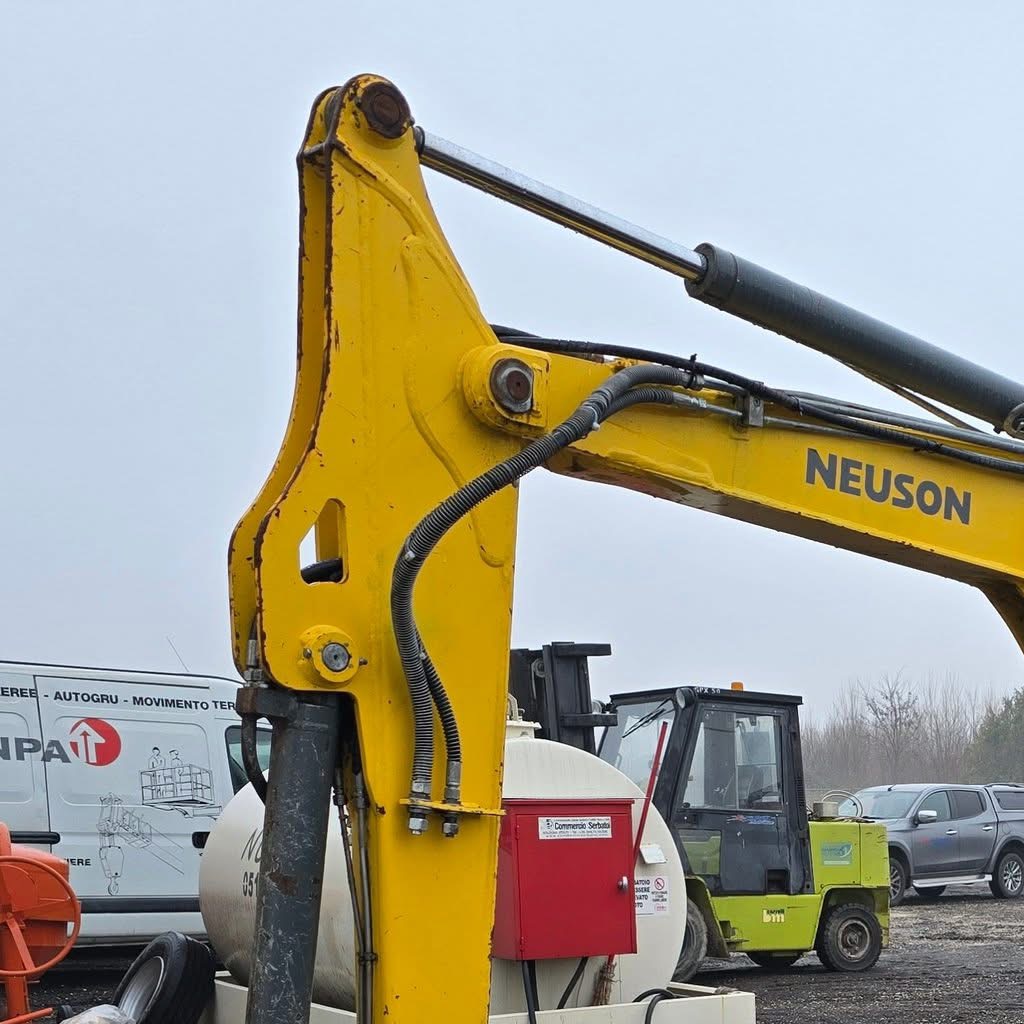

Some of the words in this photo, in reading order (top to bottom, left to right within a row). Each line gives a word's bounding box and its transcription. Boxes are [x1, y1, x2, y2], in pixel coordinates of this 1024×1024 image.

[805, 447, 972, 525] NEUSON
[0, 686, 38, 698] EREE
[53, 691, 119, 704] AUTOGRU
[132, 695, 209, 711] MOVIMENTO
[554, 822, 587, 831] Commercio
